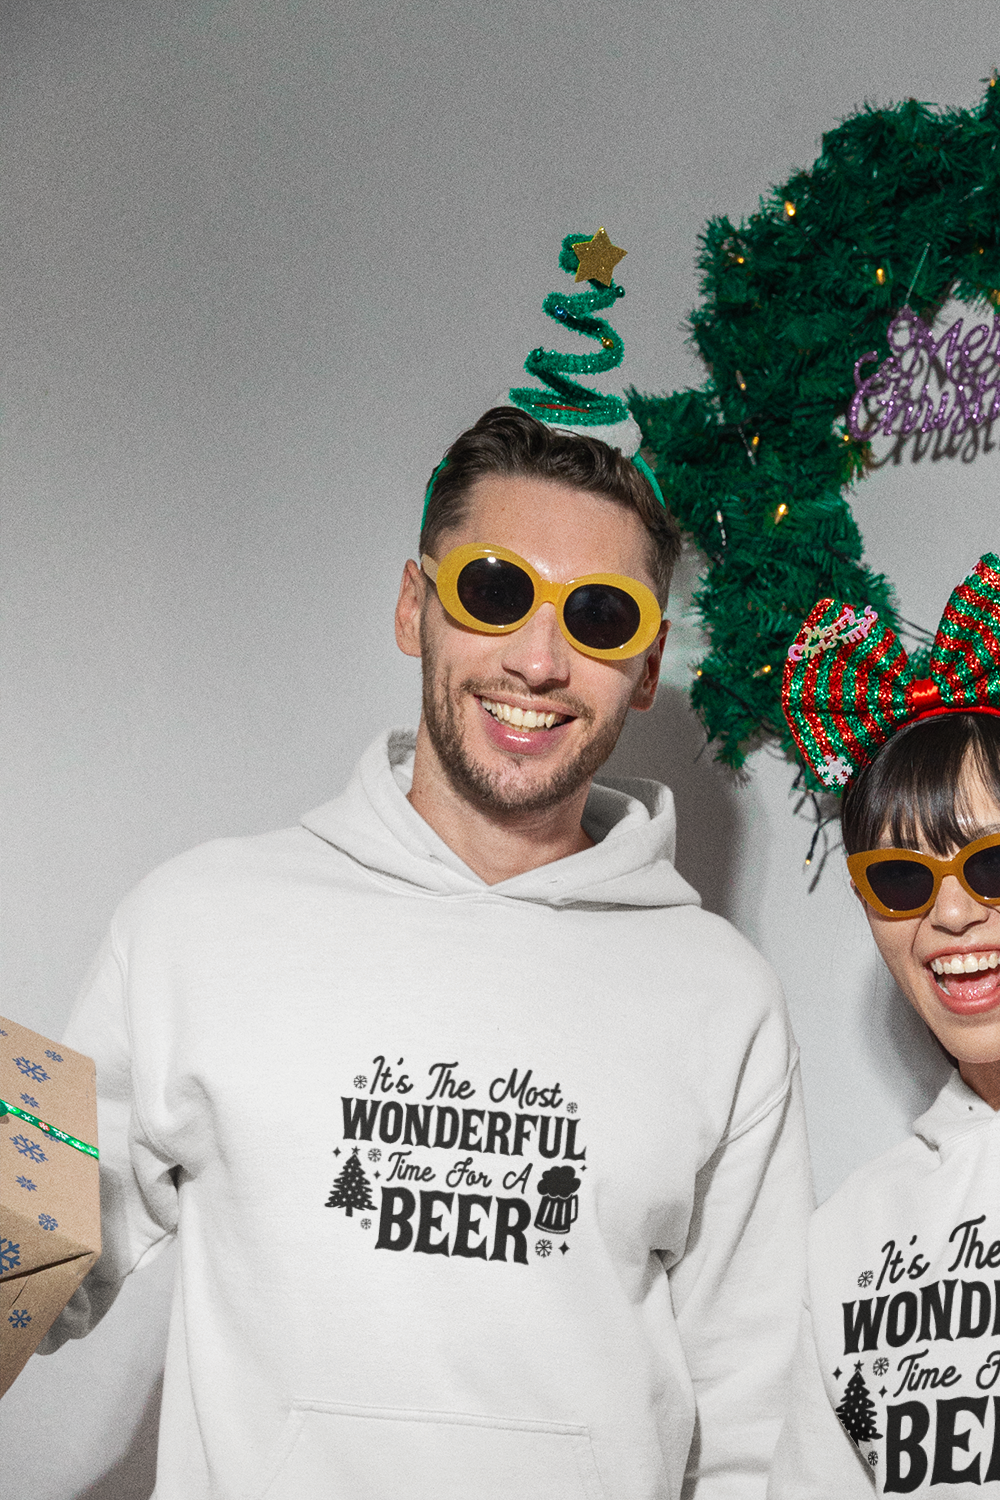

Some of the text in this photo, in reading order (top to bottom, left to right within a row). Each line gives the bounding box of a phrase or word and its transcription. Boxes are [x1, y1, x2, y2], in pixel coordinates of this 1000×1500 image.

[369, 1055, 563, 1110] It's The Most
[340, 1096, 587, 1161] WONDERFUL
[386, 1150, 533, 1195] Time For A
[374, 1186, 532, 1265] BEER
[875, 1234, 931, 1291] It's
[893, 1348, 962, 1398] Time
